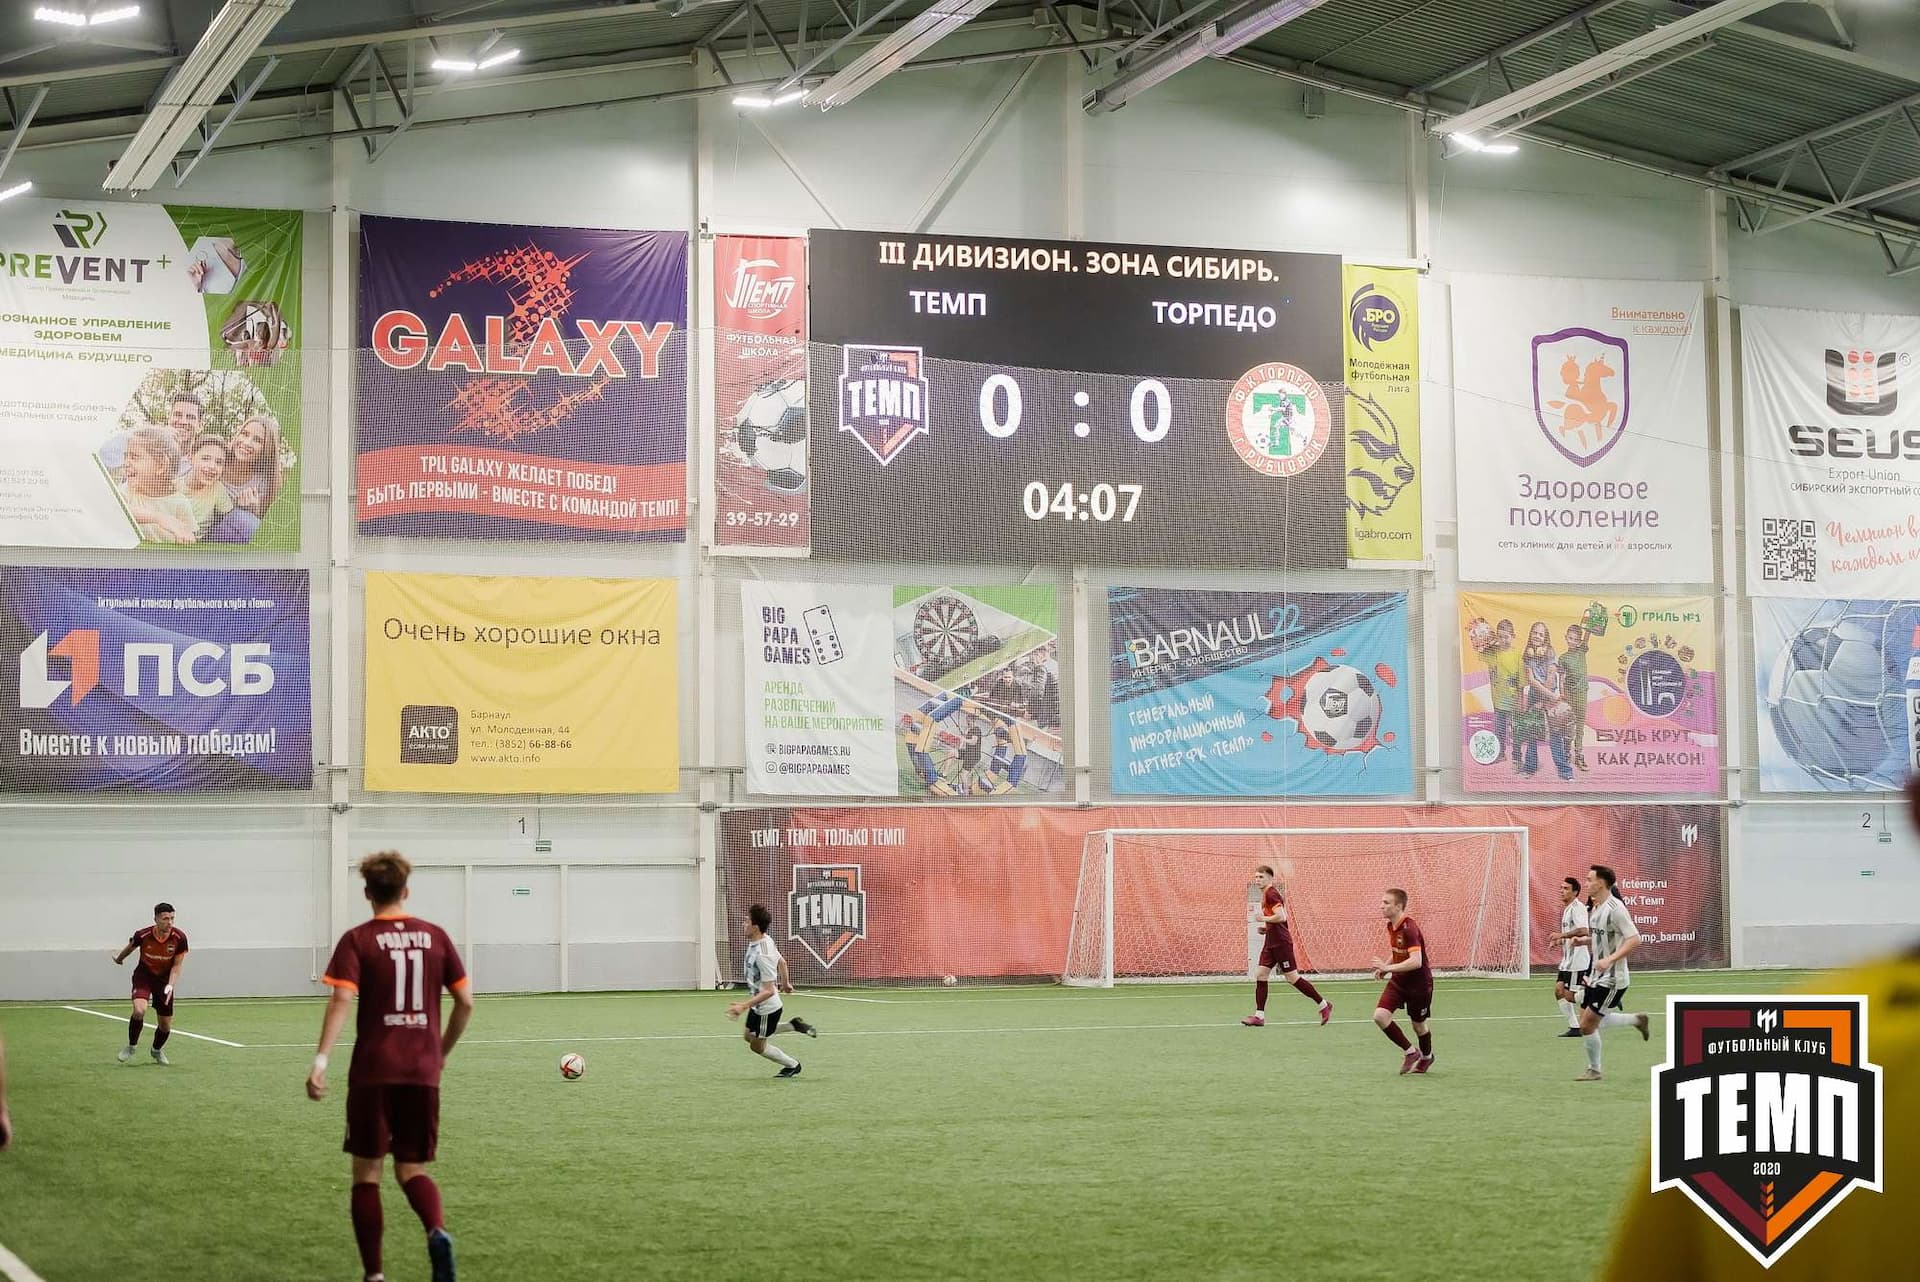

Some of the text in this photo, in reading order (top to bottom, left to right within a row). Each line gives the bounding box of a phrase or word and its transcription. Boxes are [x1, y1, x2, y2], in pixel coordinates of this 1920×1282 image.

[912, 243, 1079, 272] ДИВИЗИОН.
[1086, 251, 1160, 276] ЗОНА
[1166, 255, 1280, 282] СИБИРЬ.
[909, 290, 987, 316] ТЕМП
[0, 314, 172, 330] ОЗНАННОЕ УПРАВЛЕНИЕ
[1152, 301, 1277, 332] ТОРПЕДО
[1611, 307, 1686, 320] Внимательно
[34, 330, 122, 342] ЗДОРОВЬЕМ
[372, 309, 674, 379] GALAXY
[726, 334, 797, 345] ФУТБОЛЬНАЯ
[78, 351, 153, 364] БУДУЩЕГО
[741, 346, 780, 357] ШКОЛА
[1259, 366, 1319, 400] ТОРПЕДО
[1351, 369, 1410, 382] футбольная
[847, 379, 920, 421] ТЕМП
[979, 373, 1023, 438] 0
[1130, 378, 1172, 442] 0
[420, 456, 617, 493] ТРЦ GALAXY ЖЕЛАЕТ ПОБЕД!
[1518, 473, 1648, 502] Здоровое
[1790, 482, 1846, 494] СИБИРСКИЙ
[1848, 484, 1911, 496] ЭКСПОРТНЫЙ
[367, 483, 405, 506] БЫТЬ
[409, 480, 478, 500] ПЕРВЫМИ
[492, 485, 545, 510] ВМЕСТЕ
[549, 495, 558, 511] С
[562, 496, 636, 520] КОМАНДОЙ
[640, 499, 679, 518] ТЕМП!
[1023, 481, 1143, 522] 04:07
[726, 511, 799, 527] 39-57-29
[1509, 507, 1660, 528] поколение
[1498, 540, 1519, 549] сеть
[1520, 541, 1555, 550] клиник
[1556, 543, 1574, 551] для
[1576, 541, 1604, 551] детей
[1627, 543, 1673, 552] взрослых
[762, 606, 785, 624] BIG
[1642, 612, 1680, 623] ГРИЛЬ
[384, 618, 661, 648] Очень хорошие окна
[763, 625, 799, 645] PAPA
[763, 645, 811, 665] GAMES
[1131, 661, 1177, 679] ИНТЕРНЕТ
[1186, 645, 1249, 667] СООБЩЕСТВО
[124, 641, 275, 697] ПСБ
[764, 680, 803, 695] АРЕНДА
[470, 709, 512, 721] Барнаул
[1128, 691, 1215, 727] ГЕНЕРАЛЬНЫЙ
[409, 725, 450, 739] АКТО
[764, 715, 884, 732] НА ВАШЕ МЕРОПРИЯТИЕ
[1129, 709, 1246, 753] ИНФОРМАЦИОННЫЙ
[20, 728, 276, 757] Вместе к новым победам!
[495, 739, 526, 750] (3852)
[529, 739, 573, 749] 66-88-66
[1596, 729, 1647, 744] БУДЬ
[470, 753, 541, 764] www.akto.info
[779, 744, 851, 756] BIGPAPAGAMES.RU
[1128, 736, 1255, 777] ПАРТНЕР ФК «ТЕМП»
[779, 761, 851, 775] @BIGPAPAGAMES
[1597, 752, 1705, 768] КАК ДРАКОН!
[517, 816, 525, 834] 1
[1861, 811, 1871, 828] 2
[750, 827, 905, 848] ТЕМП, ТЕМП, ТОЛЬКО ТЕМП!
[1622, 879, 1668, 891] fctemp.ru
[1639, 896, 1665, 905] Темп
[796, 893, 859, 929] ТЕМП
[389, 949, 424, 1012] 11
